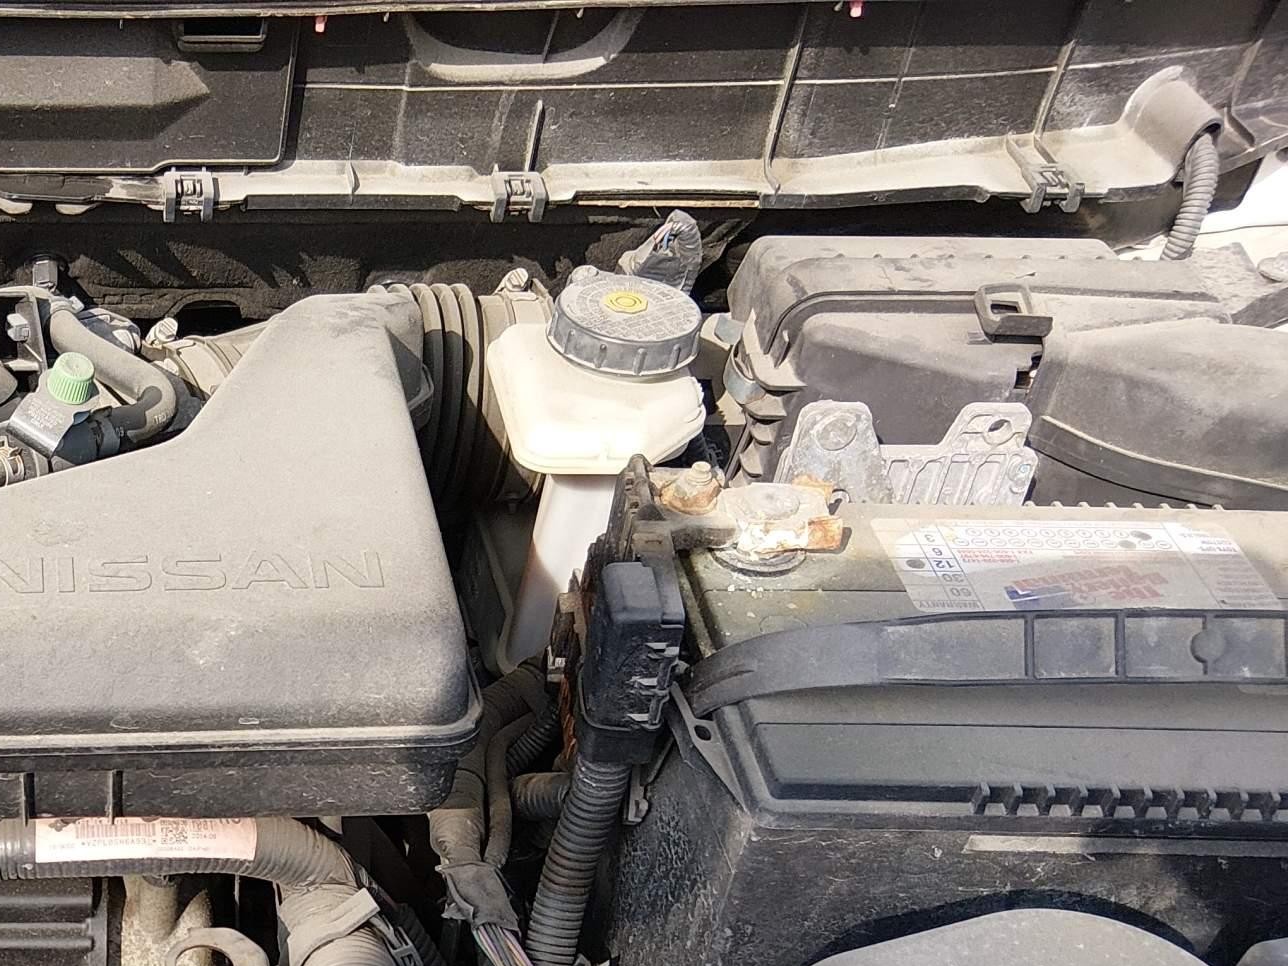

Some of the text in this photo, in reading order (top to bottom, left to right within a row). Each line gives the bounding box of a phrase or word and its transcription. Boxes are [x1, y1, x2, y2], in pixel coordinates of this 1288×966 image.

[925, 534, 935, 543] 3
[933, 547, 943, 556] 6
[935, 560, 954, 569] 12
[943, 574, 963, 583] 30
[919, 601, 980, 609] WARRANTY
